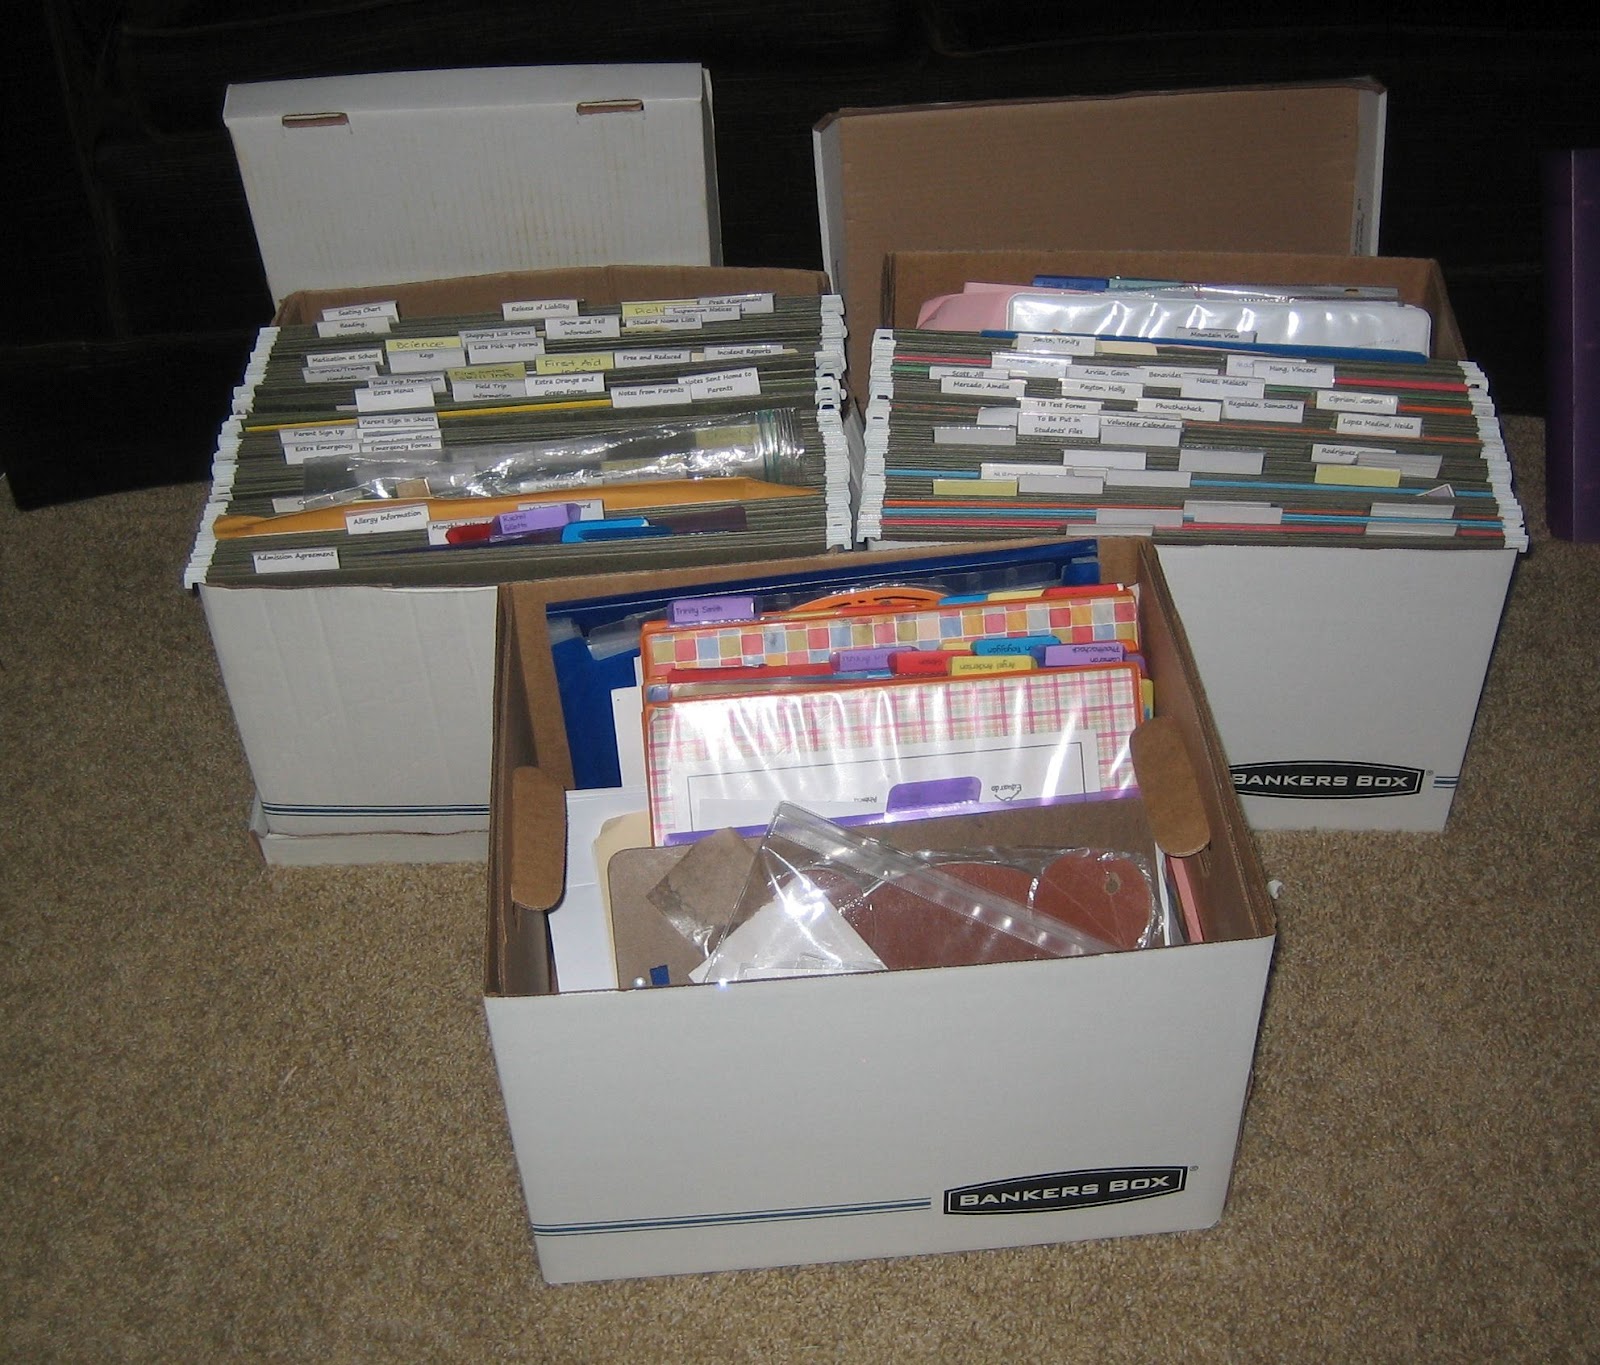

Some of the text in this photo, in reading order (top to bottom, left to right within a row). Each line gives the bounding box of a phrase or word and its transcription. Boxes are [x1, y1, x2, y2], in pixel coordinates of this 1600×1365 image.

[1190, 331, 1221, 339] Mountain
[396, 340, 445, 349] Science
[1057, 337, 1080, 347] Trinity
[746, 348, 772, 356] Reports
[312, 355, 347, 363] Medication
[581, 357, 601, 366] Aid
[1291, 366, 1317, 374] Vincent
[705, 375, 721, 383] Sent
[707, 385, 733, 393] Parents
[953, 381, 985, 390] Mercado,
[1079, 383, 1126, 394] Payton, Holly
[638, 388, 656, 396] from
[658, 387, 685, 395] Parents
[1263, 402, 1298, 410] Samantha
[1107, 420, 1141, 428] Volunteer
[1365, 420, 1392, 429] Medina,
[318, 430, 333, 438] Sign
[335, 429, 345, 437] Up
[316, 443, 353, 451] Emergency
[353, 510, 422, 525] Allergy Information
[257, 551, 335, 561] Admission Agreement
[675, 605, 723, 617] Trinity Smith
[1233, 773, 1409, 787] BANKERS BOX
[991, 784, 1022, 792] Eduardo
[959, 1175, 1170, 1207] BANKERS BOX
